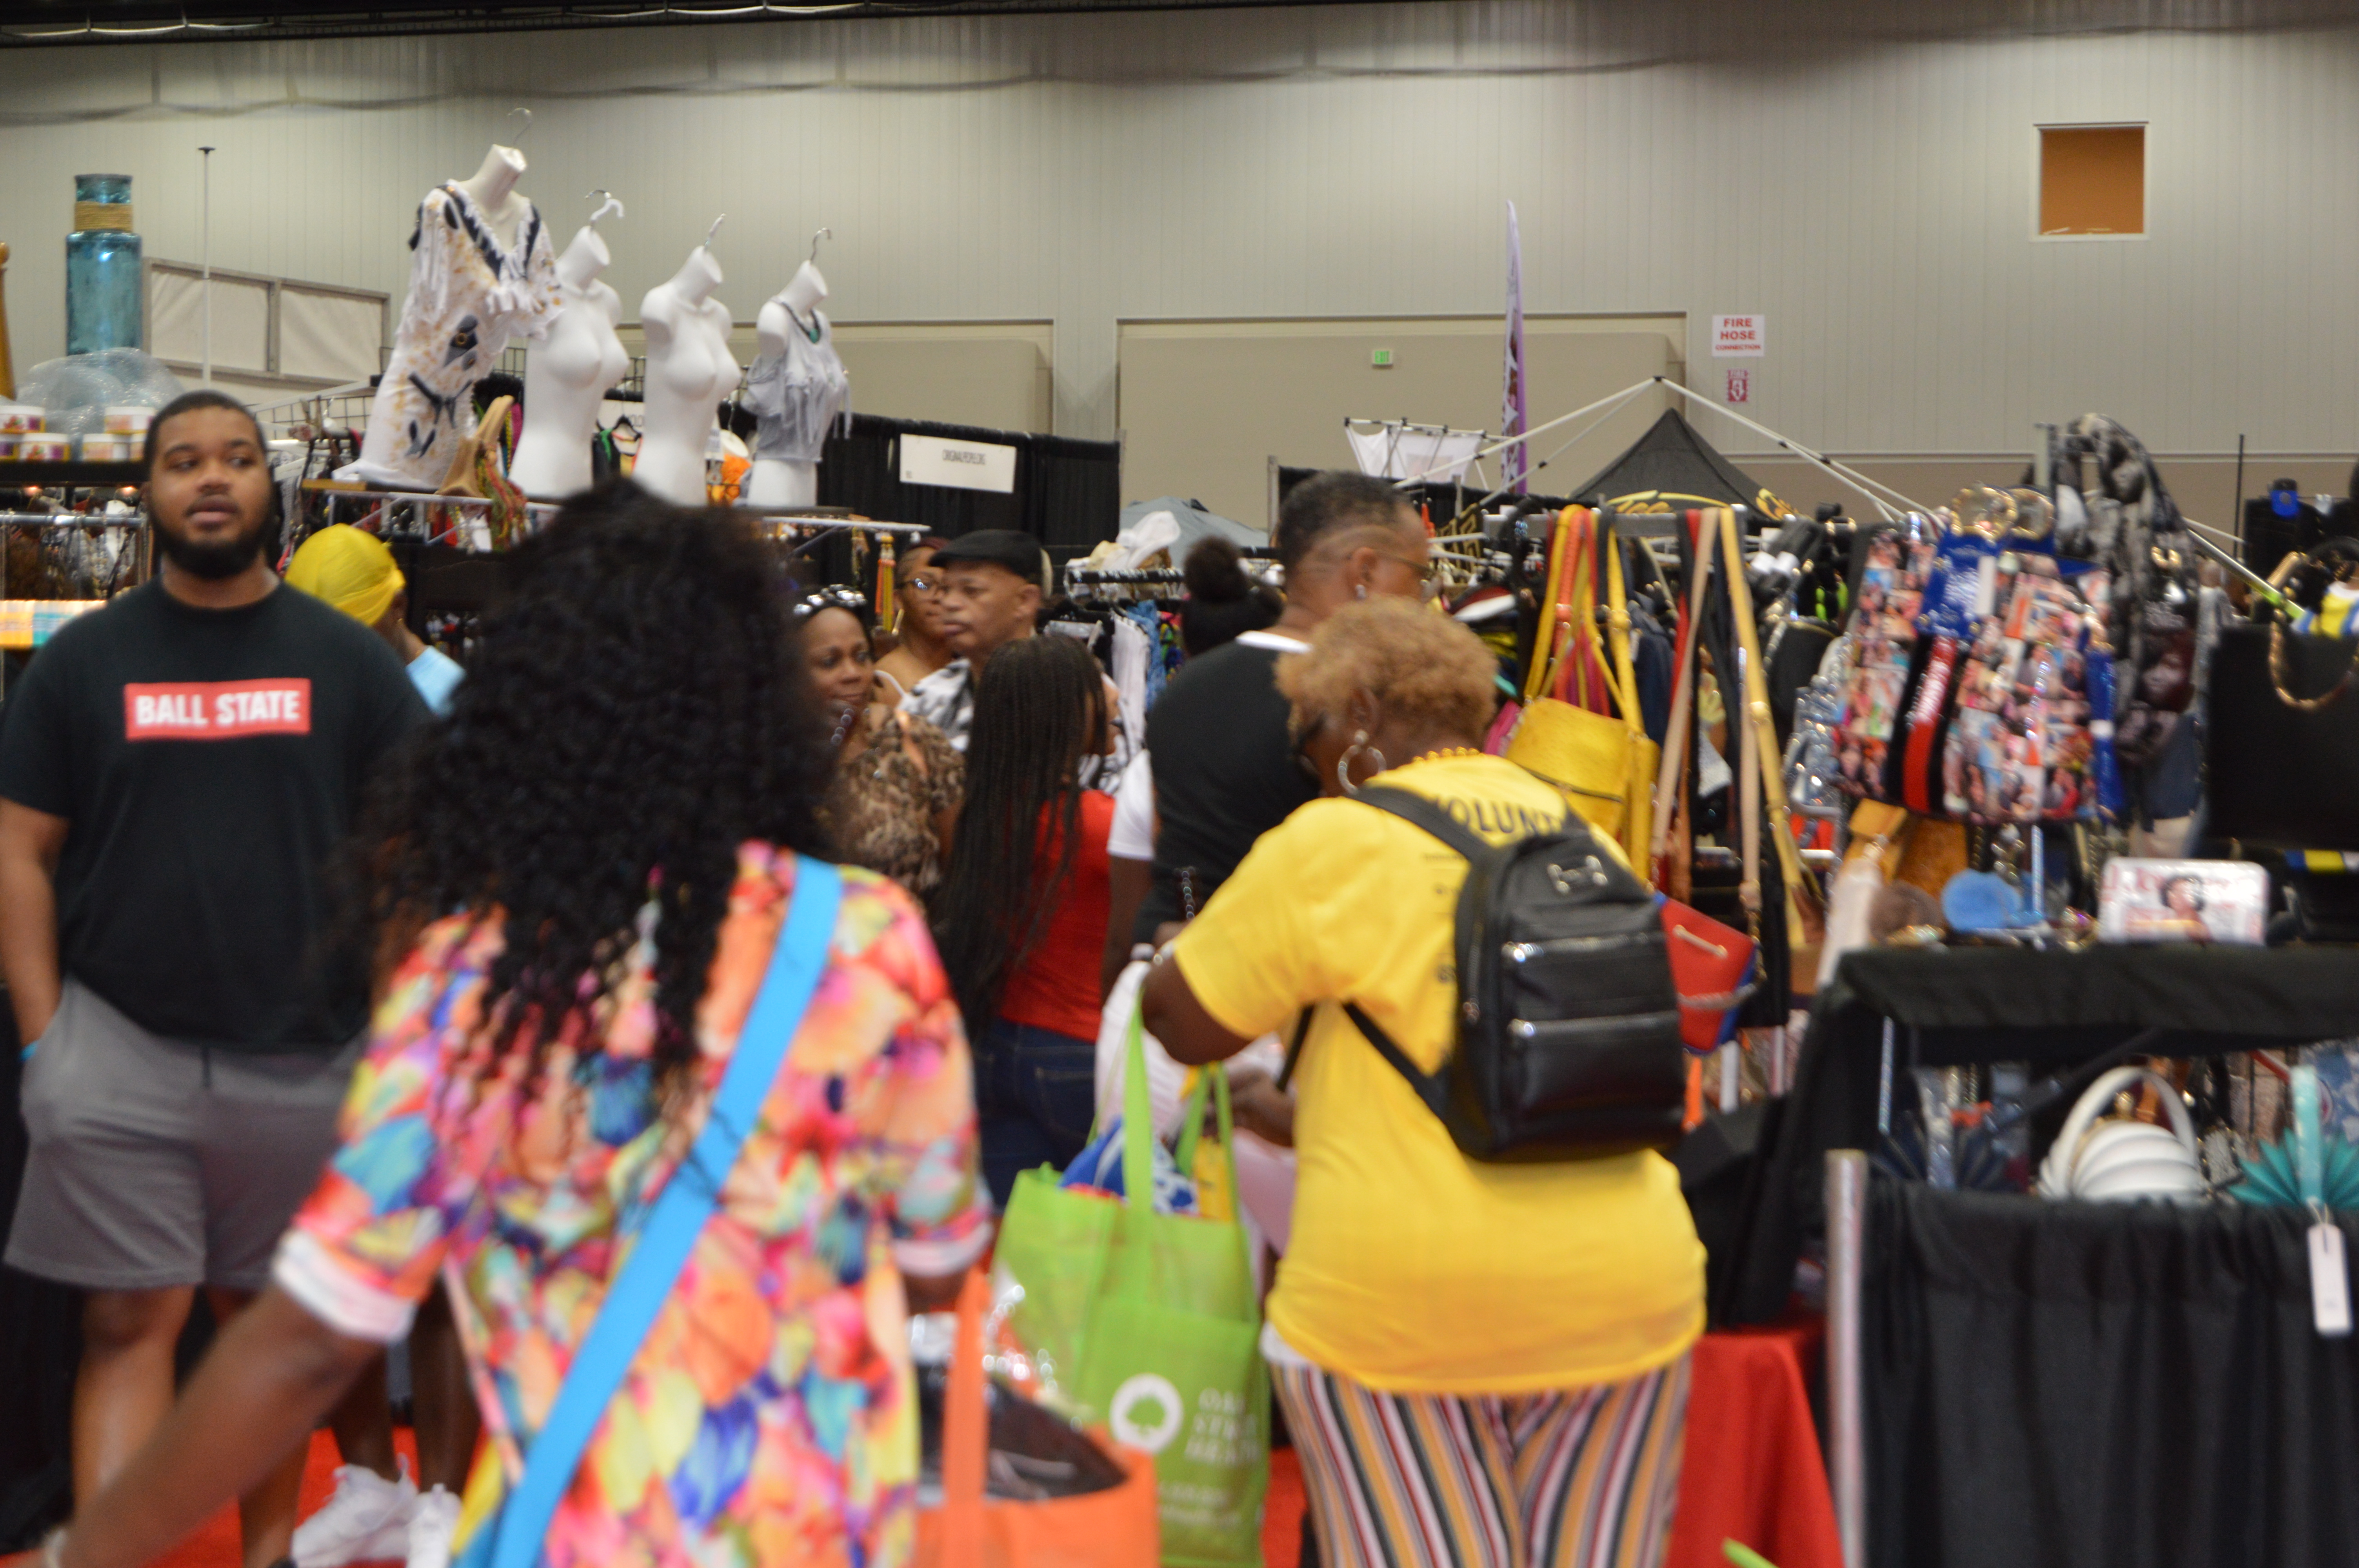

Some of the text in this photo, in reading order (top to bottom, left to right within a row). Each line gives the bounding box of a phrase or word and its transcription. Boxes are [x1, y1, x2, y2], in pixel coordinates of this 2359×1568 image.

[1724, 318, 1752, 327] FIRE
[1720, 330, 1756, 340] HOSE
[135, 690, 301, 726] BALL STATE
